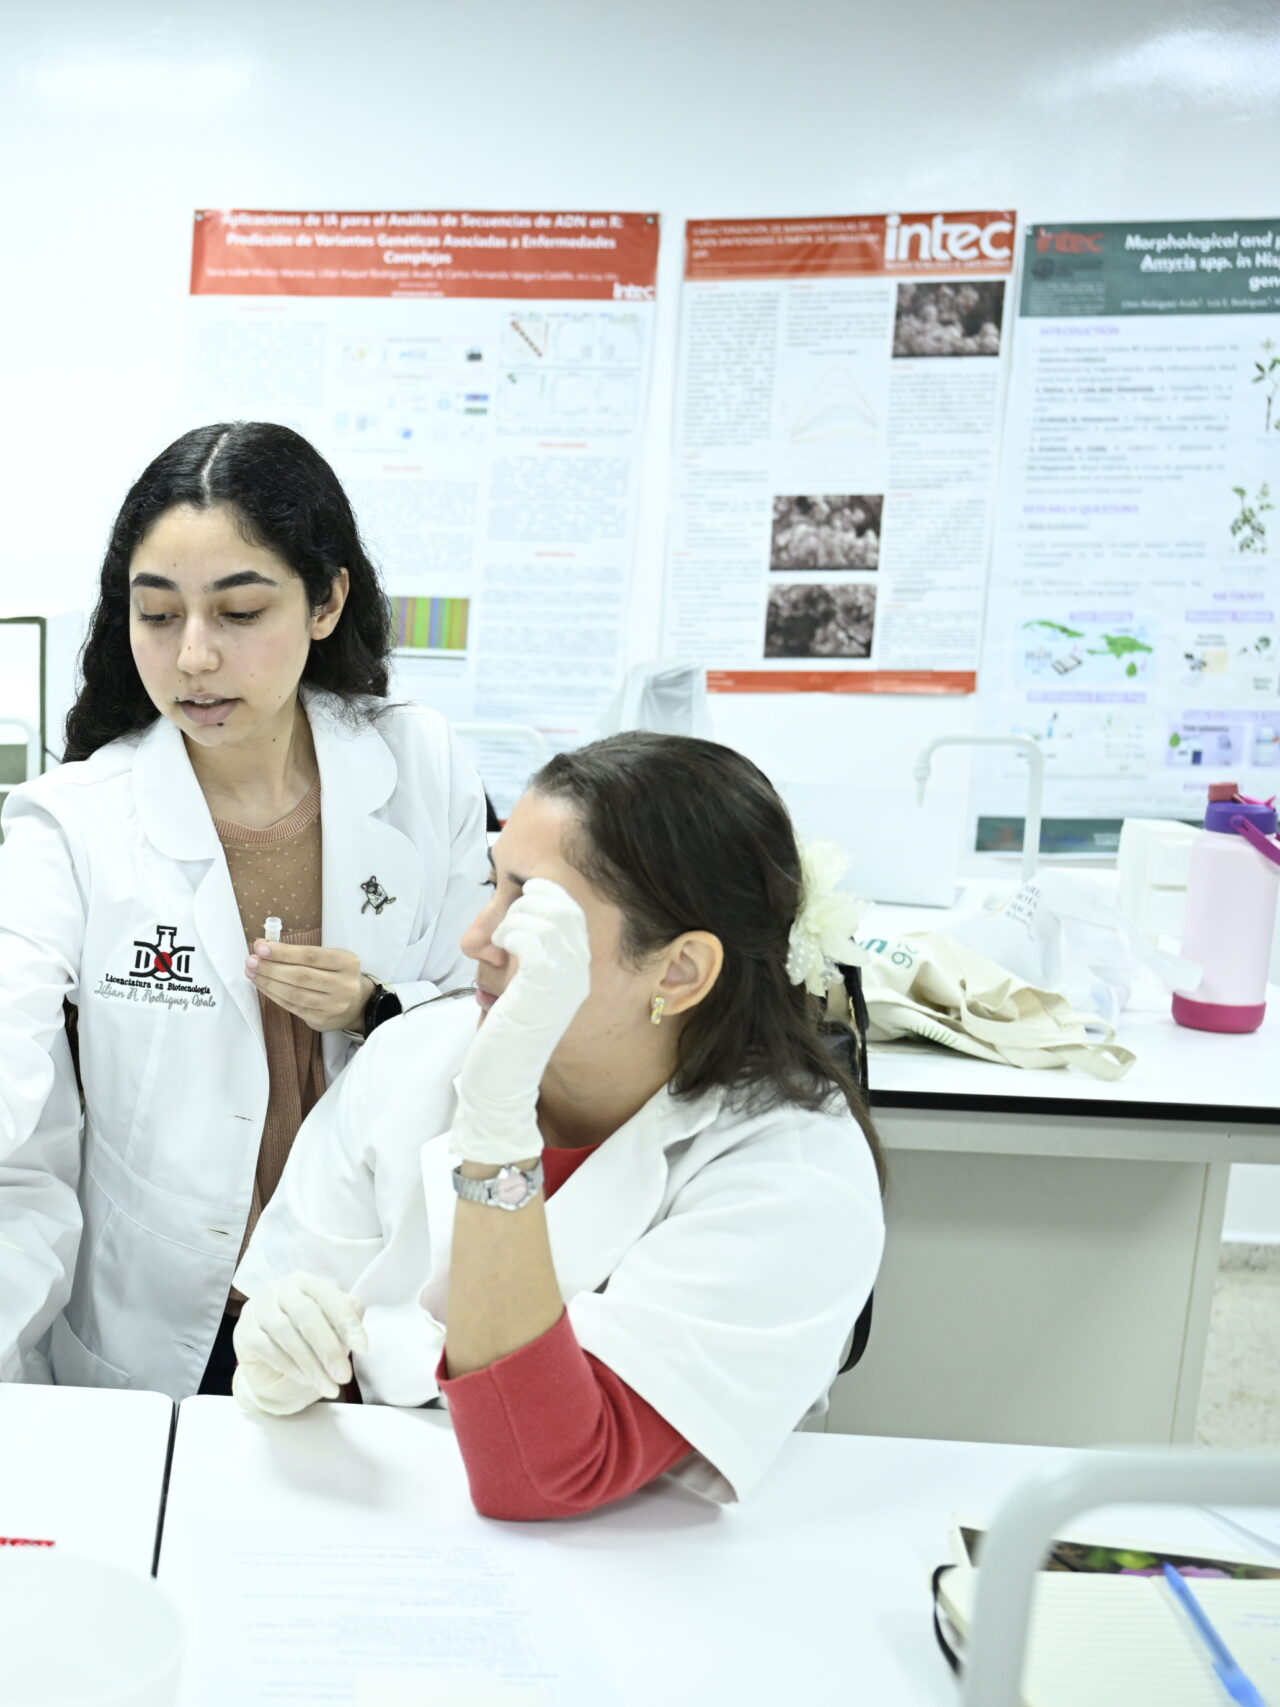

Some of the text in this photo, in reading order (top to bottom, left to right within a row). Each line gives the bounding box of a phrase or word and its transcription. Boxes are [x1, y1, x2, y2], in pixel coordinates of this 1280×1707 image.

[304, 213, 320, 227] de
[340, 214, 370, 230] para
[373, 213, 387, 227] el
[441, 213, 458, 227] de
[461, 213, 531, 228] Secuencias
[534, 214, 551, 228] de
[554, 215, 587, 228] ADN
[589, 217, 606, 228] en
[295, 233, 312, 247] de
[315, 234, 375, 247] Variantes
[443, 234, 508, 248] Asociadas
[522, 234, 617, 249] Enfermedades
[884, 215, 1013, 262] intec
[1124, 231, 1239, 253] Morphological
[1240, 230, 1273, 249] and
[383, 250, 452, 267] Complejas
[1236, 252, 1252, 268] in
[105, 973, 211, 996] Licenciatura en Biotecnología
